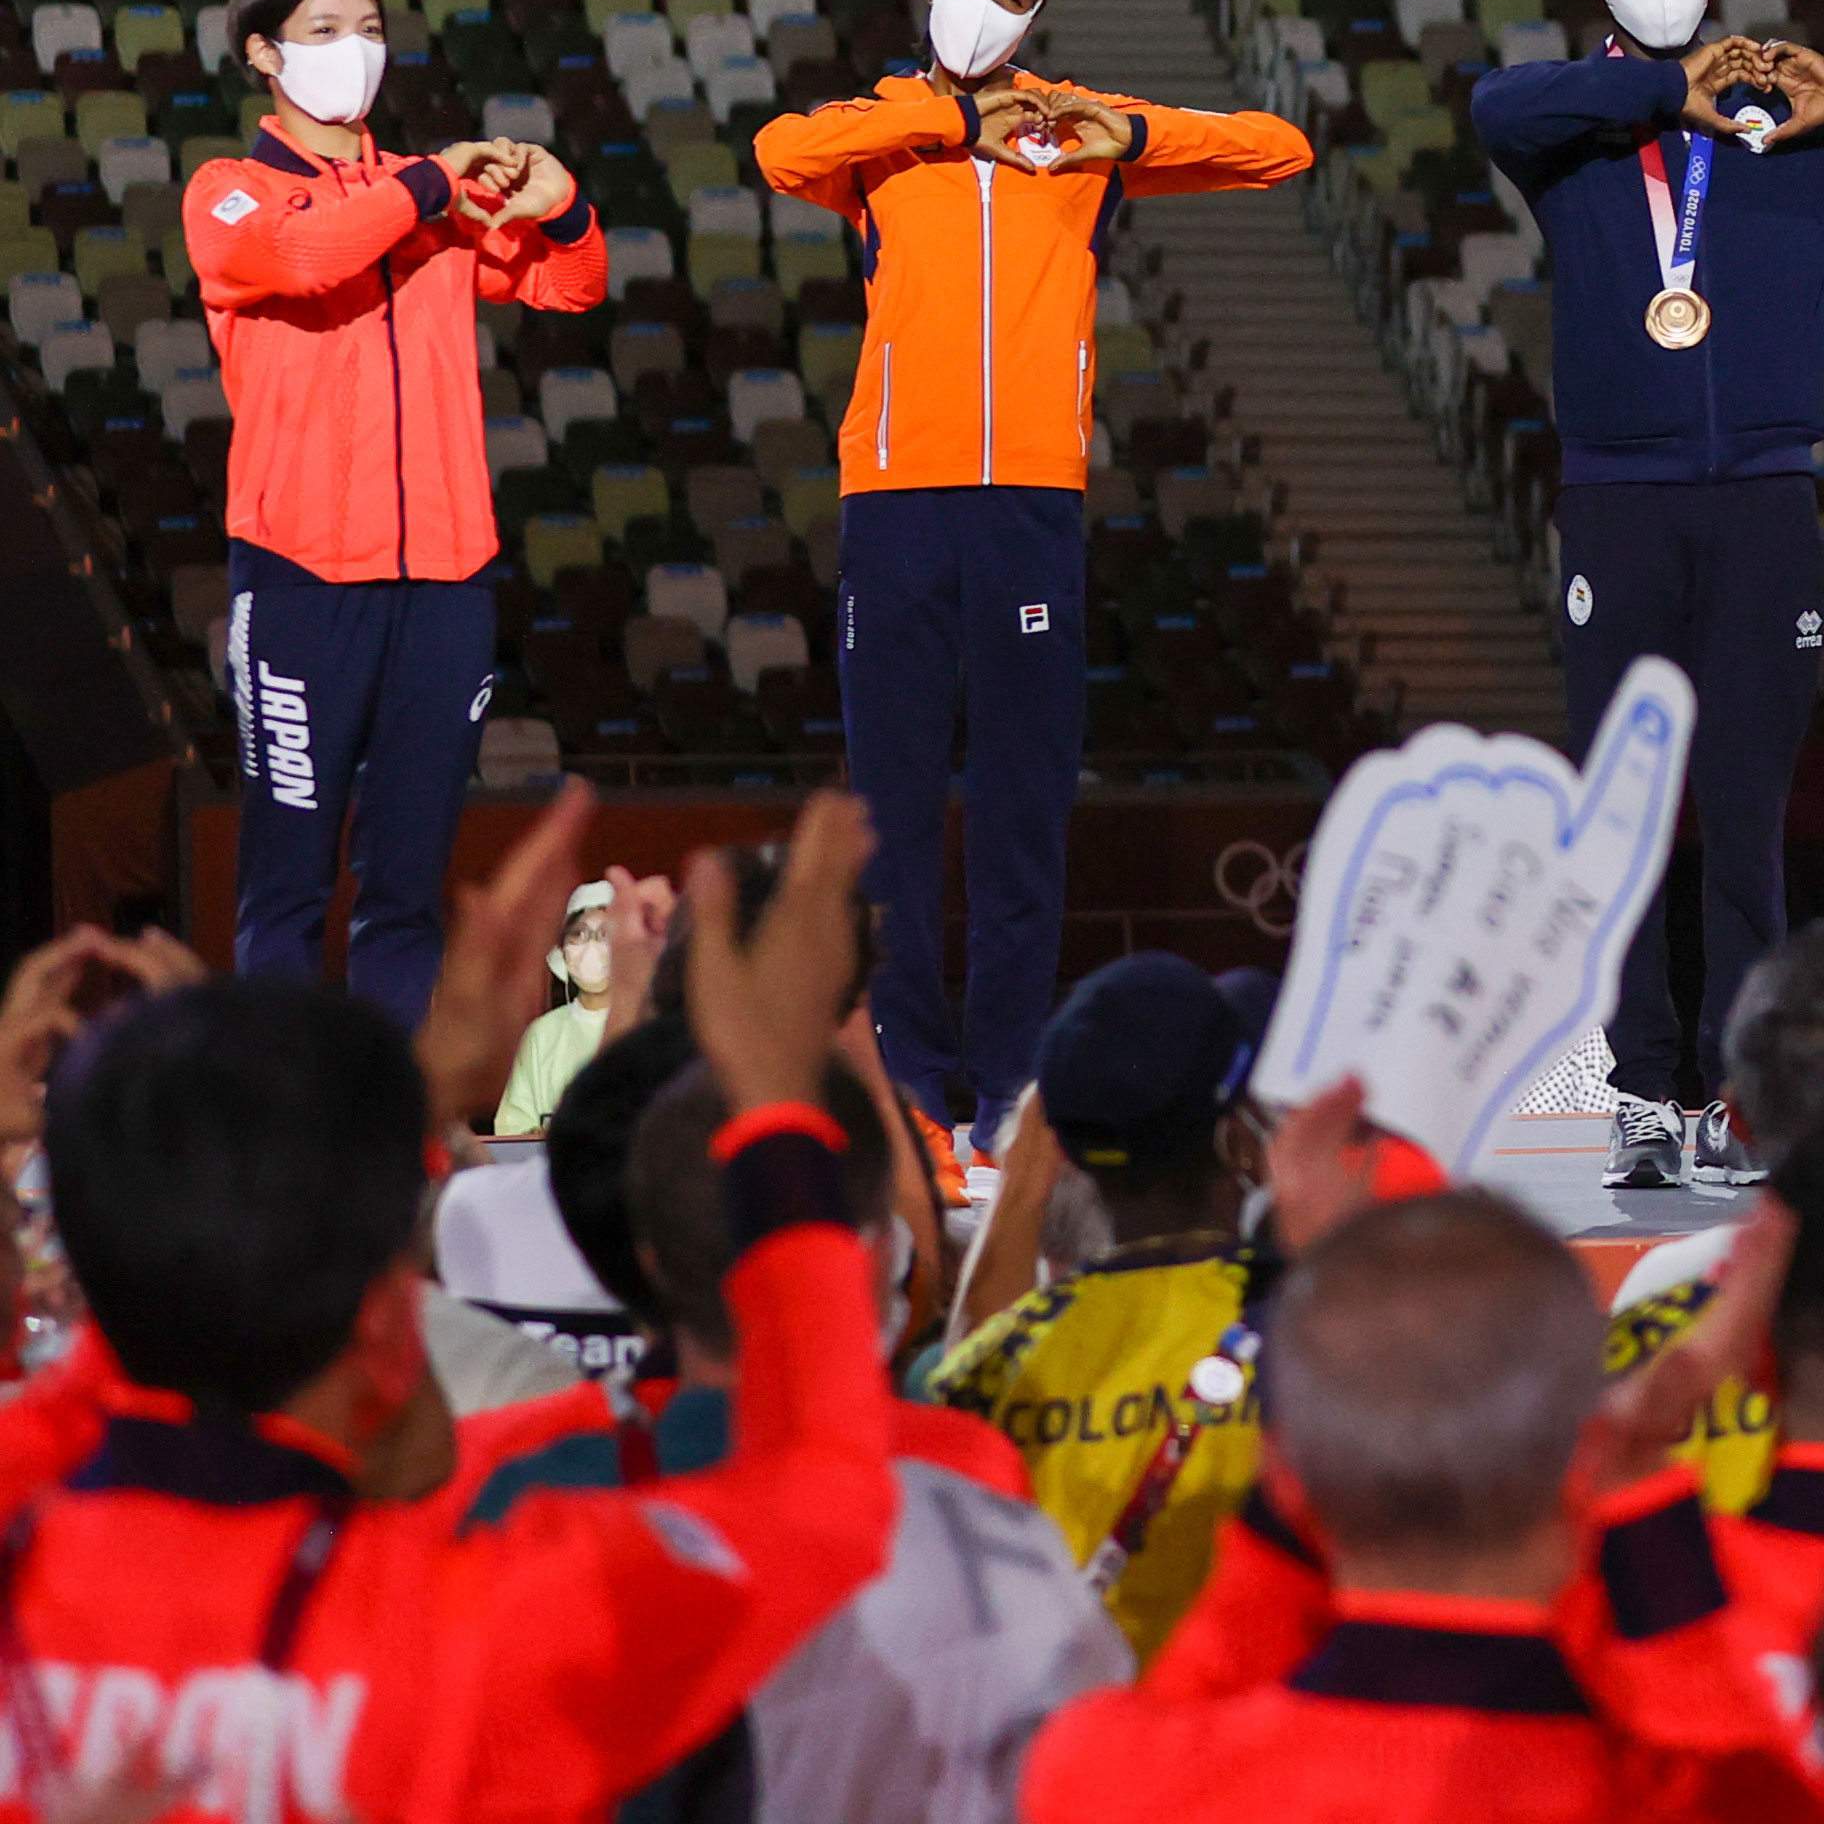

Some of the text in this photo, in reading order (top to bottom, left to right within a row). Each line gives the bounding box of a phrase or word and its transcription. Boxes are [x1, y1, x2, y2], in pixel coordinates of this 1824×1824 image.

[1678, 188, 1701, 253] TOKYO 2020
[257, 659, 318, 810] JAPAN
